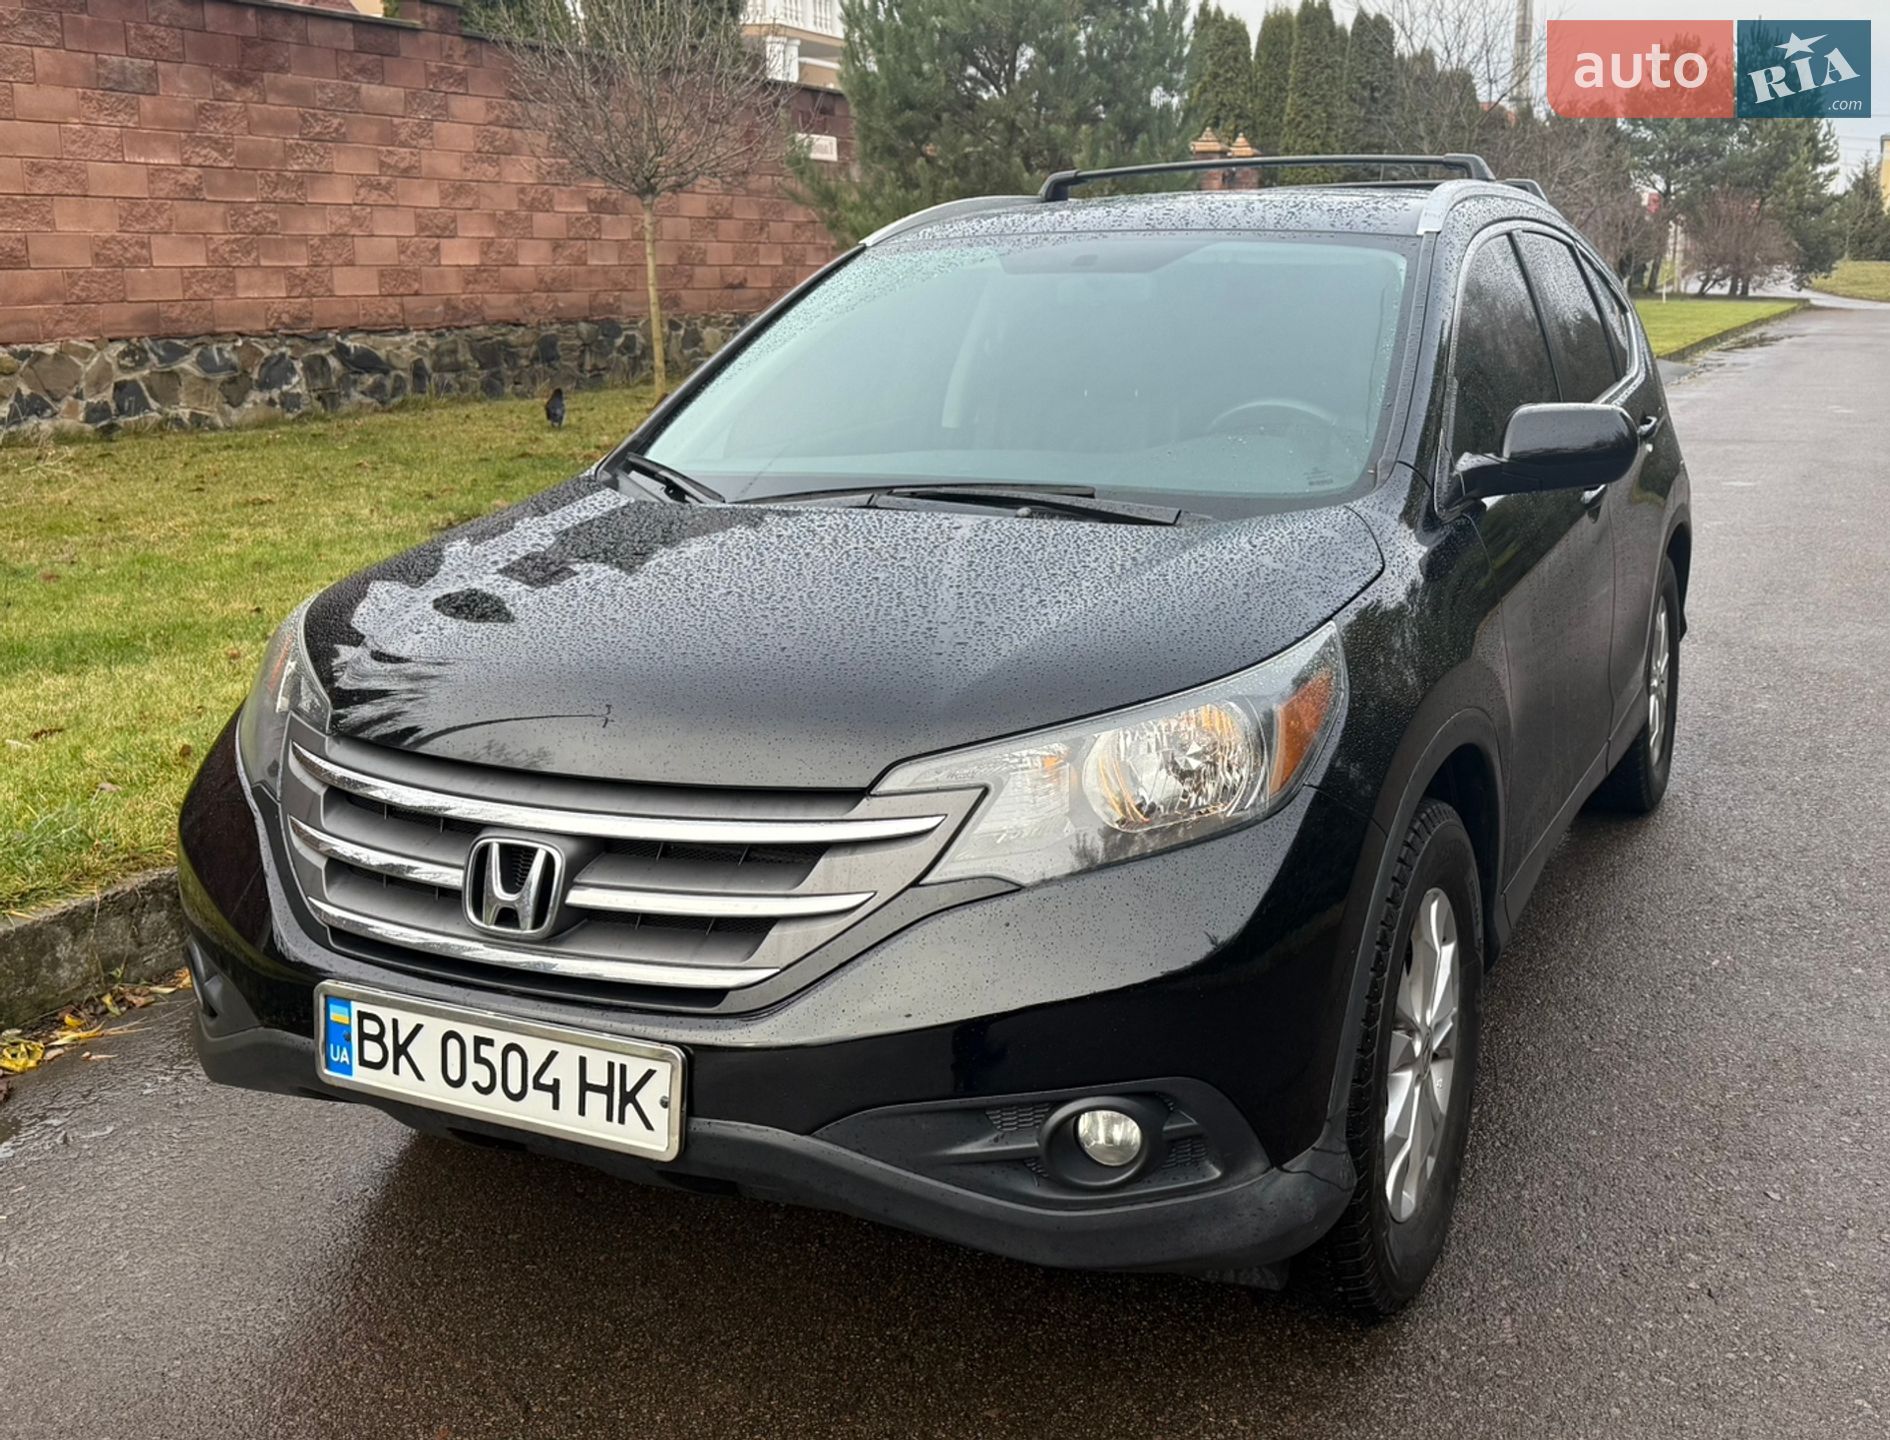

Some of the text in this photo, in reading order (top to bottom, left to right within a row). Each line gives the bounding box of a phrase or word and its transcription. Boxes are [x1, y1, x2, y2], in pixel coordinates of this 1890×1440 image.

[330, 1043, 350, 1065] UA
[357, 1010, 658, 1132] BK 0504 HK
